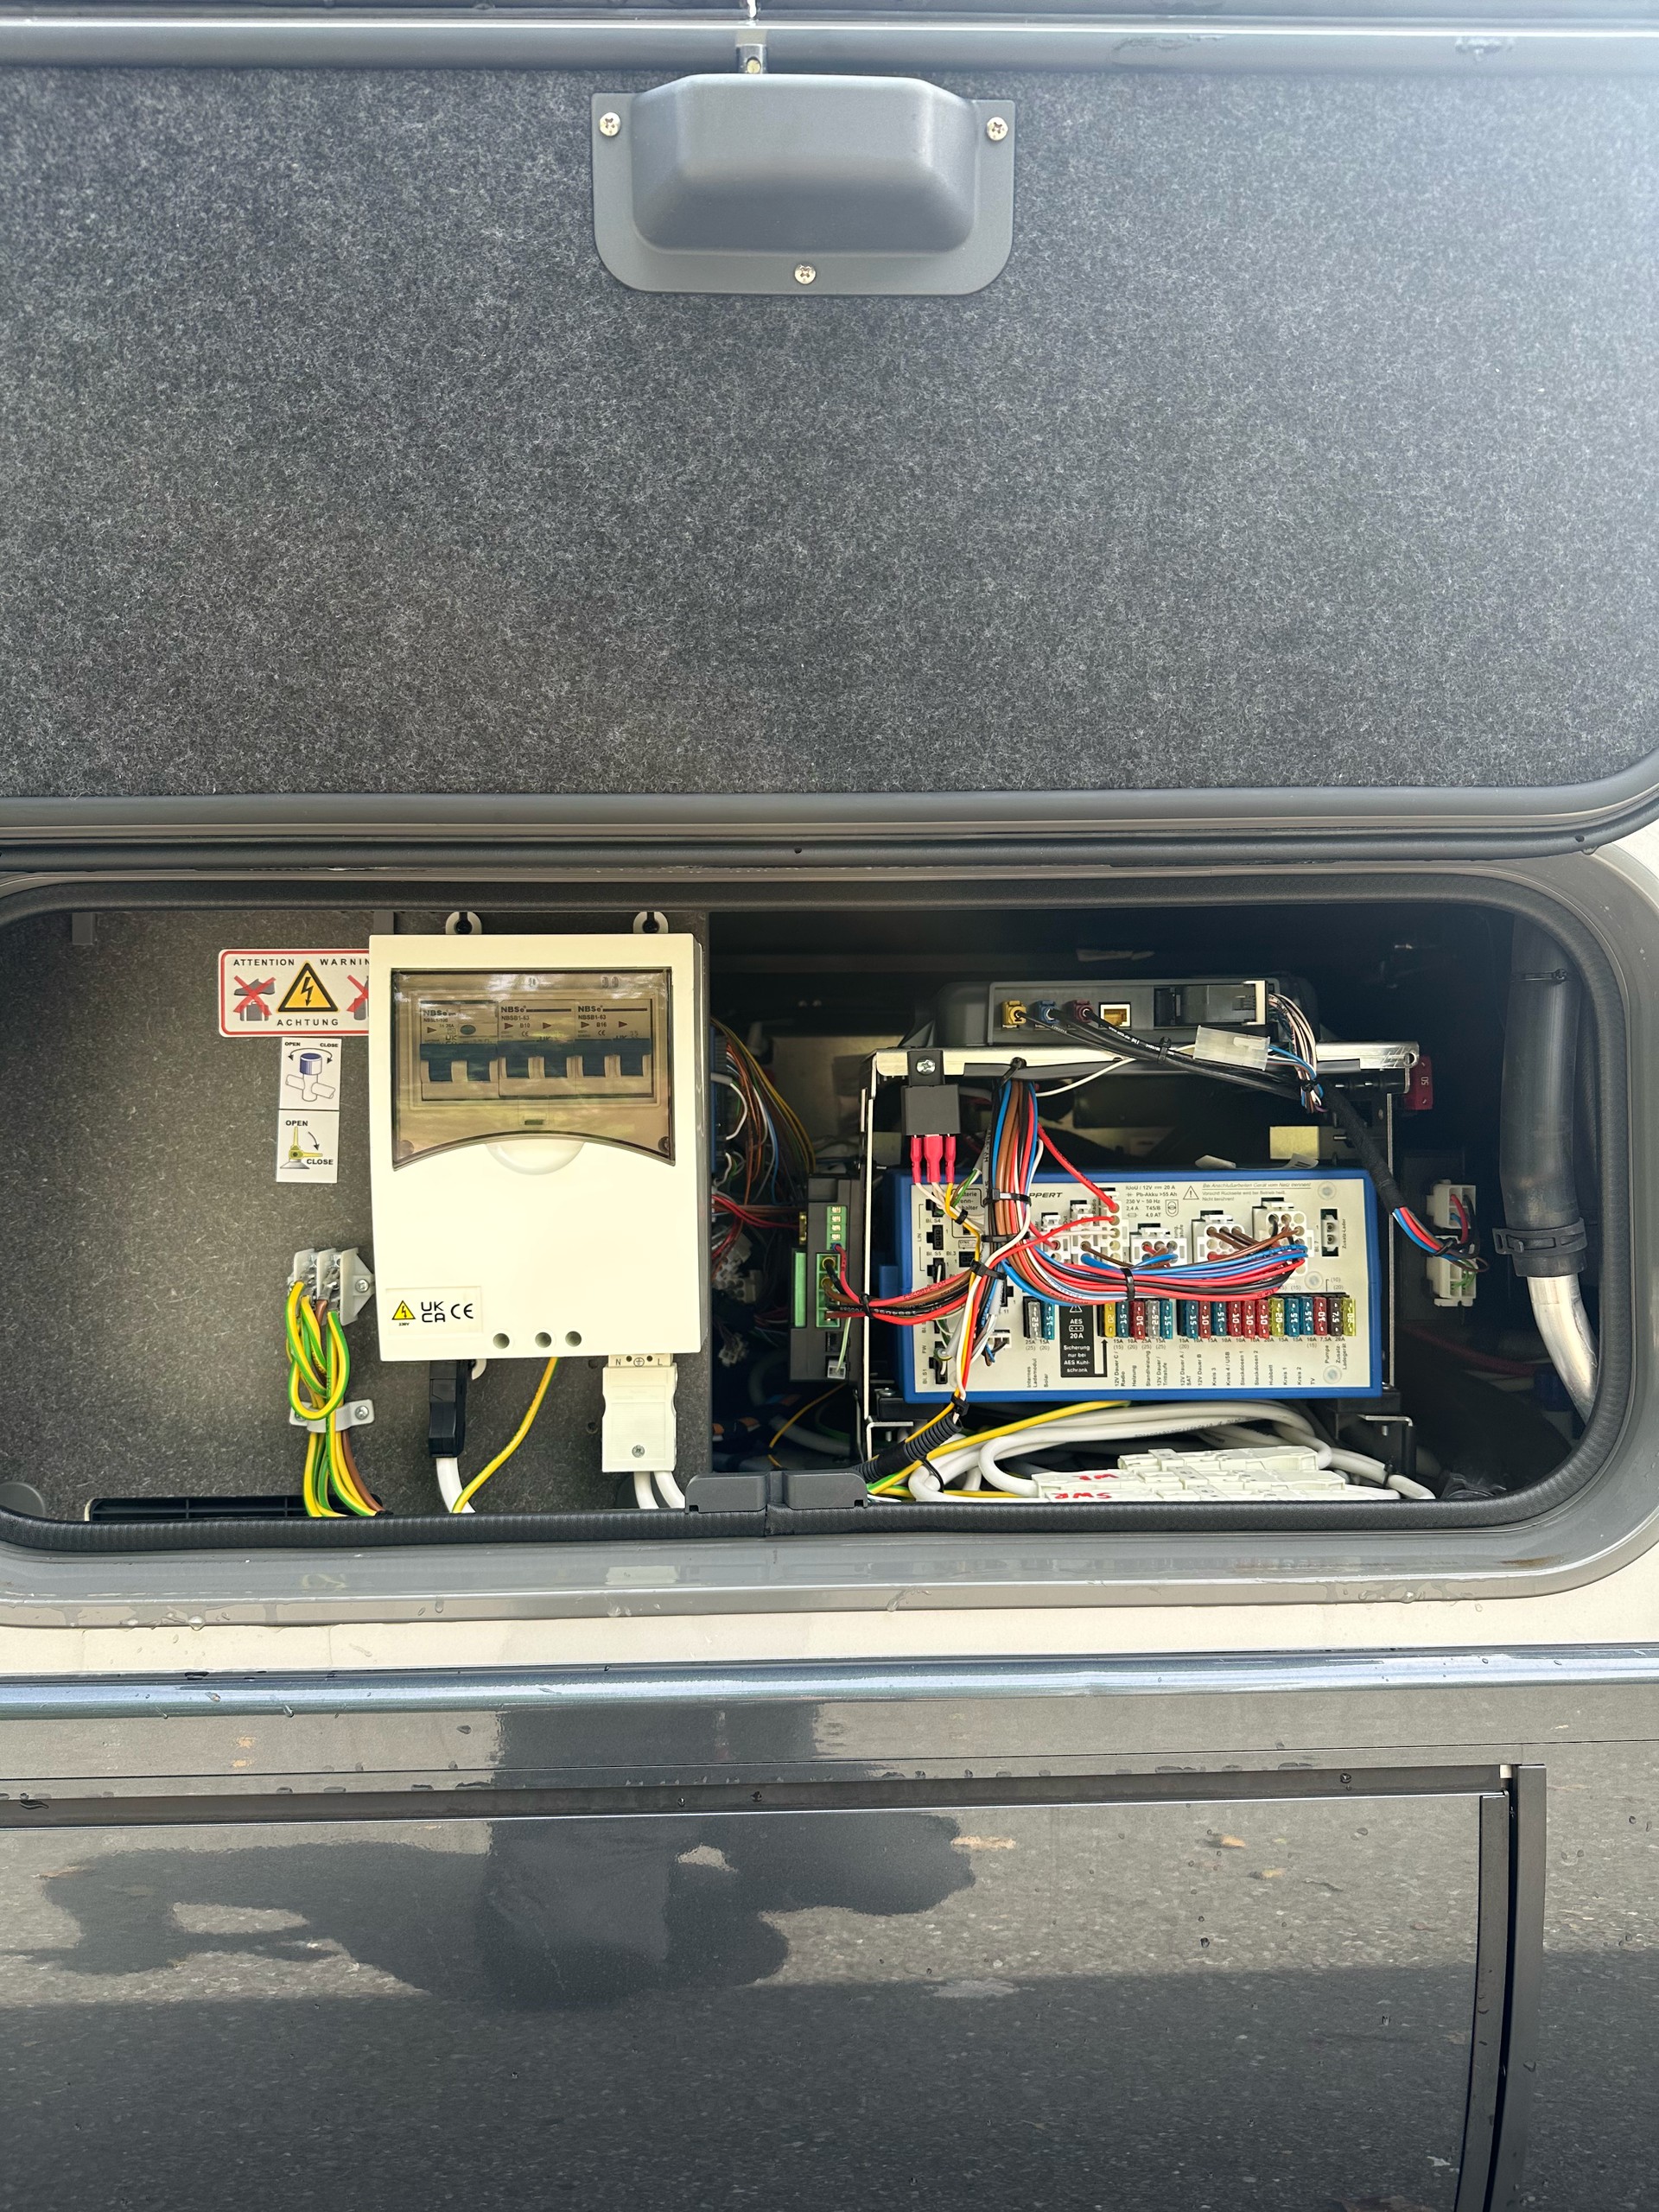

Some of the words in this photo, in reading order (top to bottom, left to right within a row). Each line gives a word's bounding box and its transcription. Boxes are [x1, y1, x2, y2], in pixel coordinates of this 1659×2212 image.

[421, 1300, 444, 1312] UK
[450, 1303, 474, 1319] CE
[422, 1313, 446, 1323] CA
[1046, 1315, 1054, 1325] 15
[1107, 1314, 1115, 1324] 20
[1120, 1313, 1128, 1325] 15
[1136, 1315, 1144, 1326] 10
[1151, 1314, 1160, 1325] 25
[1164, 1315, 1172, 1325] 15
[1190, 1315, 1198, 1325] 15
[1202, 1314, 1210, 1325] 10
[1217, 1312, 1225, 1322] 15
[1232, 1313, 1240, 1324] 10
[1246, 1314, 1254, 1325] 10
[1260, 1314, 1268, 1325] 10
[1275, 1312, 1283, 1323] 20
[1290, 1313, 1299, 1323] 15
[1305, 1311, 1313, 1321] 15
[1318, 1311, 1326, 1322] 10
[1346, 1313, 1355, 1323] 20
[1031, 1317, 1039, 1328] 25
